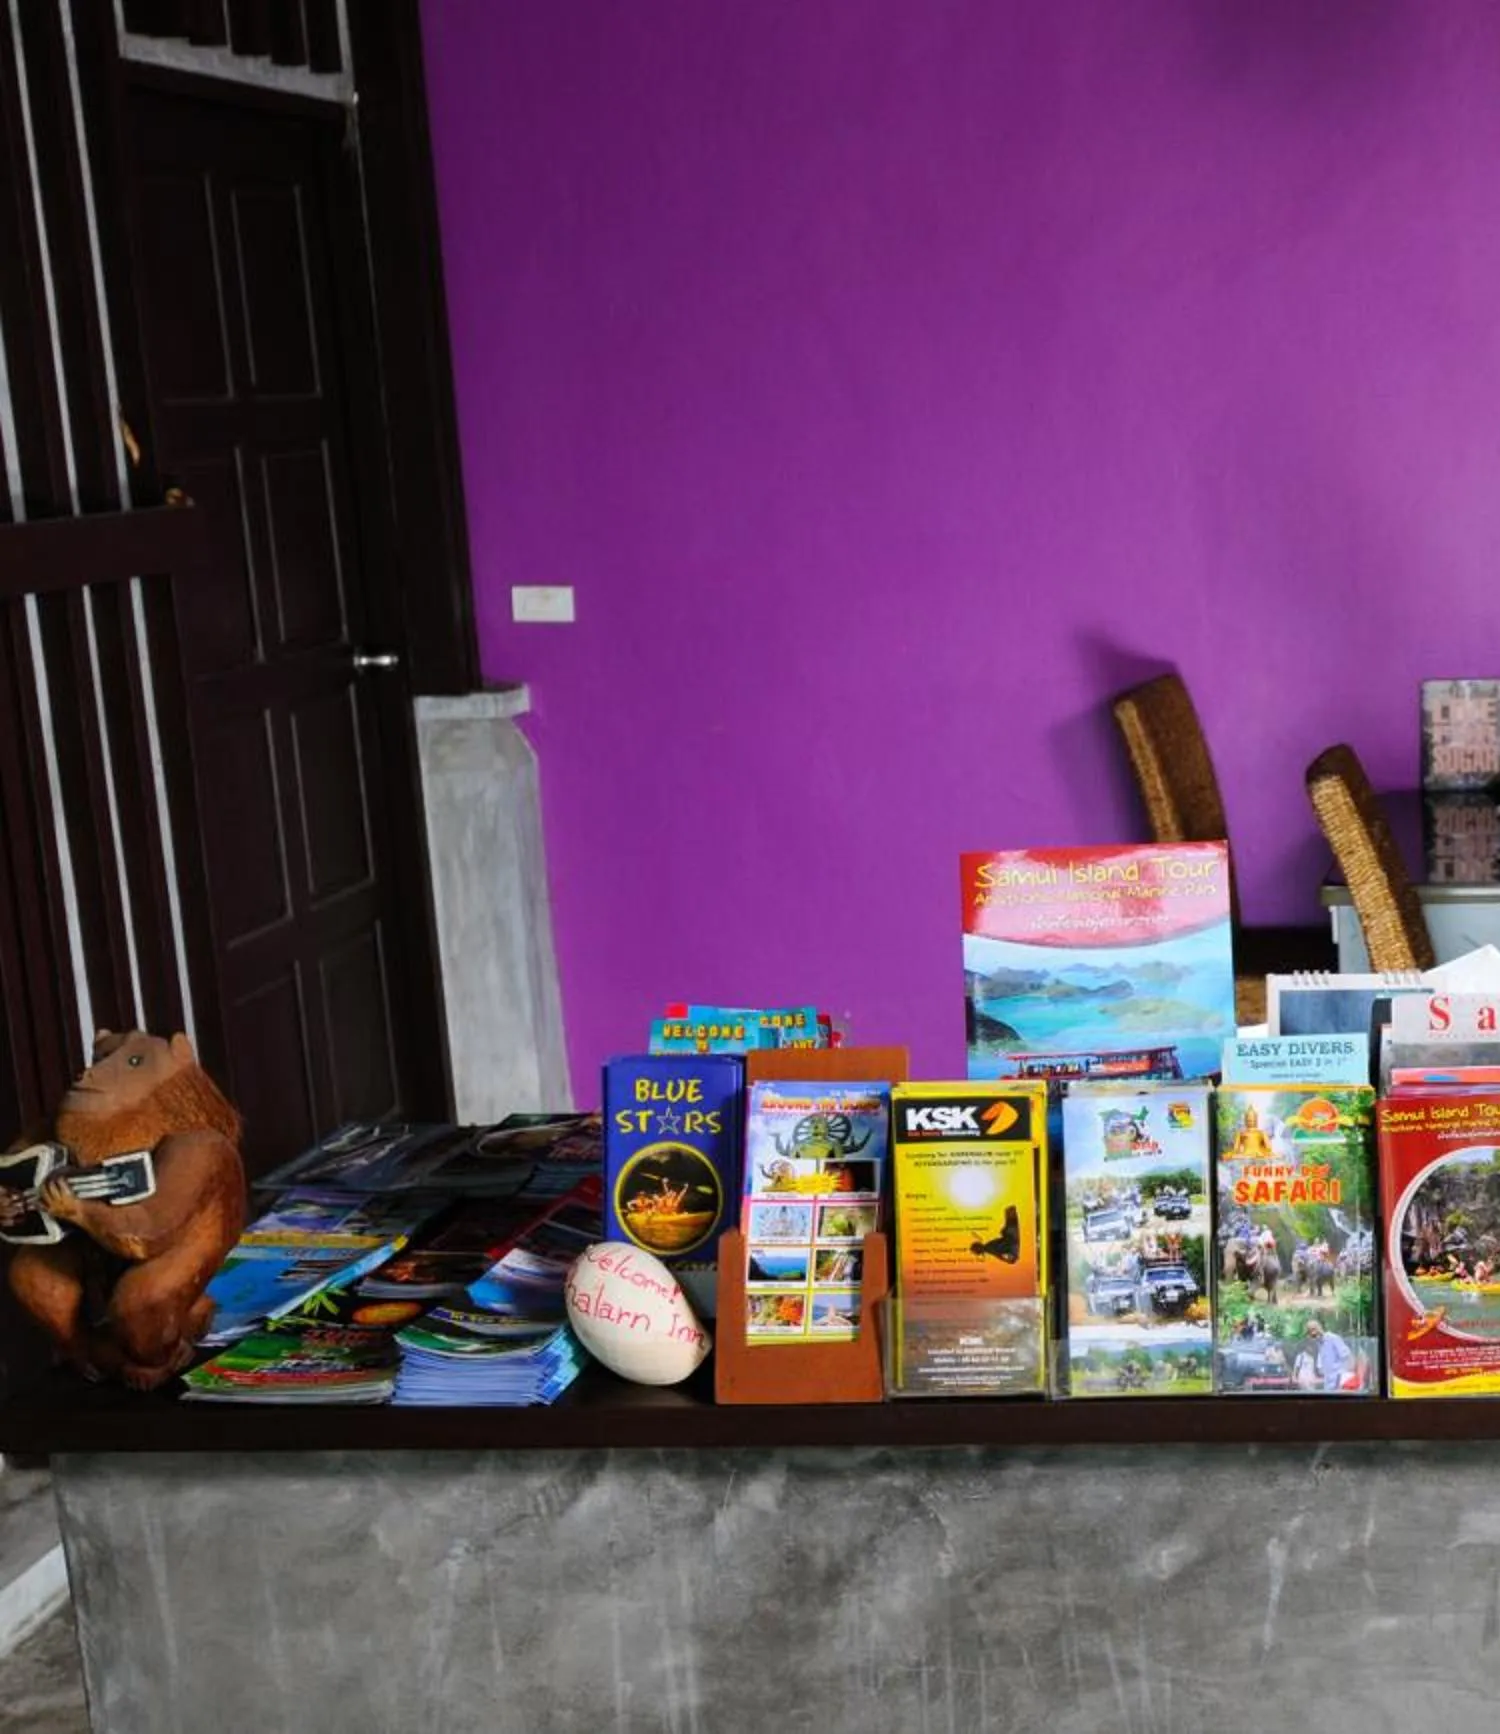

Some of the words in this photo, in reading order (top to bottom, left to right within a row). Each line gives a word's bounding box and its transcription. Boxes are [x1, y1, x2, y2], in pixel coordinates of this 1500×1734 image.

[975, 863, 1058, 889] Samui
[1068, 861, 1139, 884] Island
[1151, 857, 1219, 880] Tour
[663, 1022, 745, 1040] WELCOME
[1236, 1042, 1282, 1057] EASY
[1288, 1041, 1355, 1056] DIVERS
[635, 1078, 705, 1103] BLUE
[905, 1105, 980, 1131] KSK
[1243, 1164, 1297, 1178] FUNNY
[1235, 1178, 1342, 1204] SAFARI
